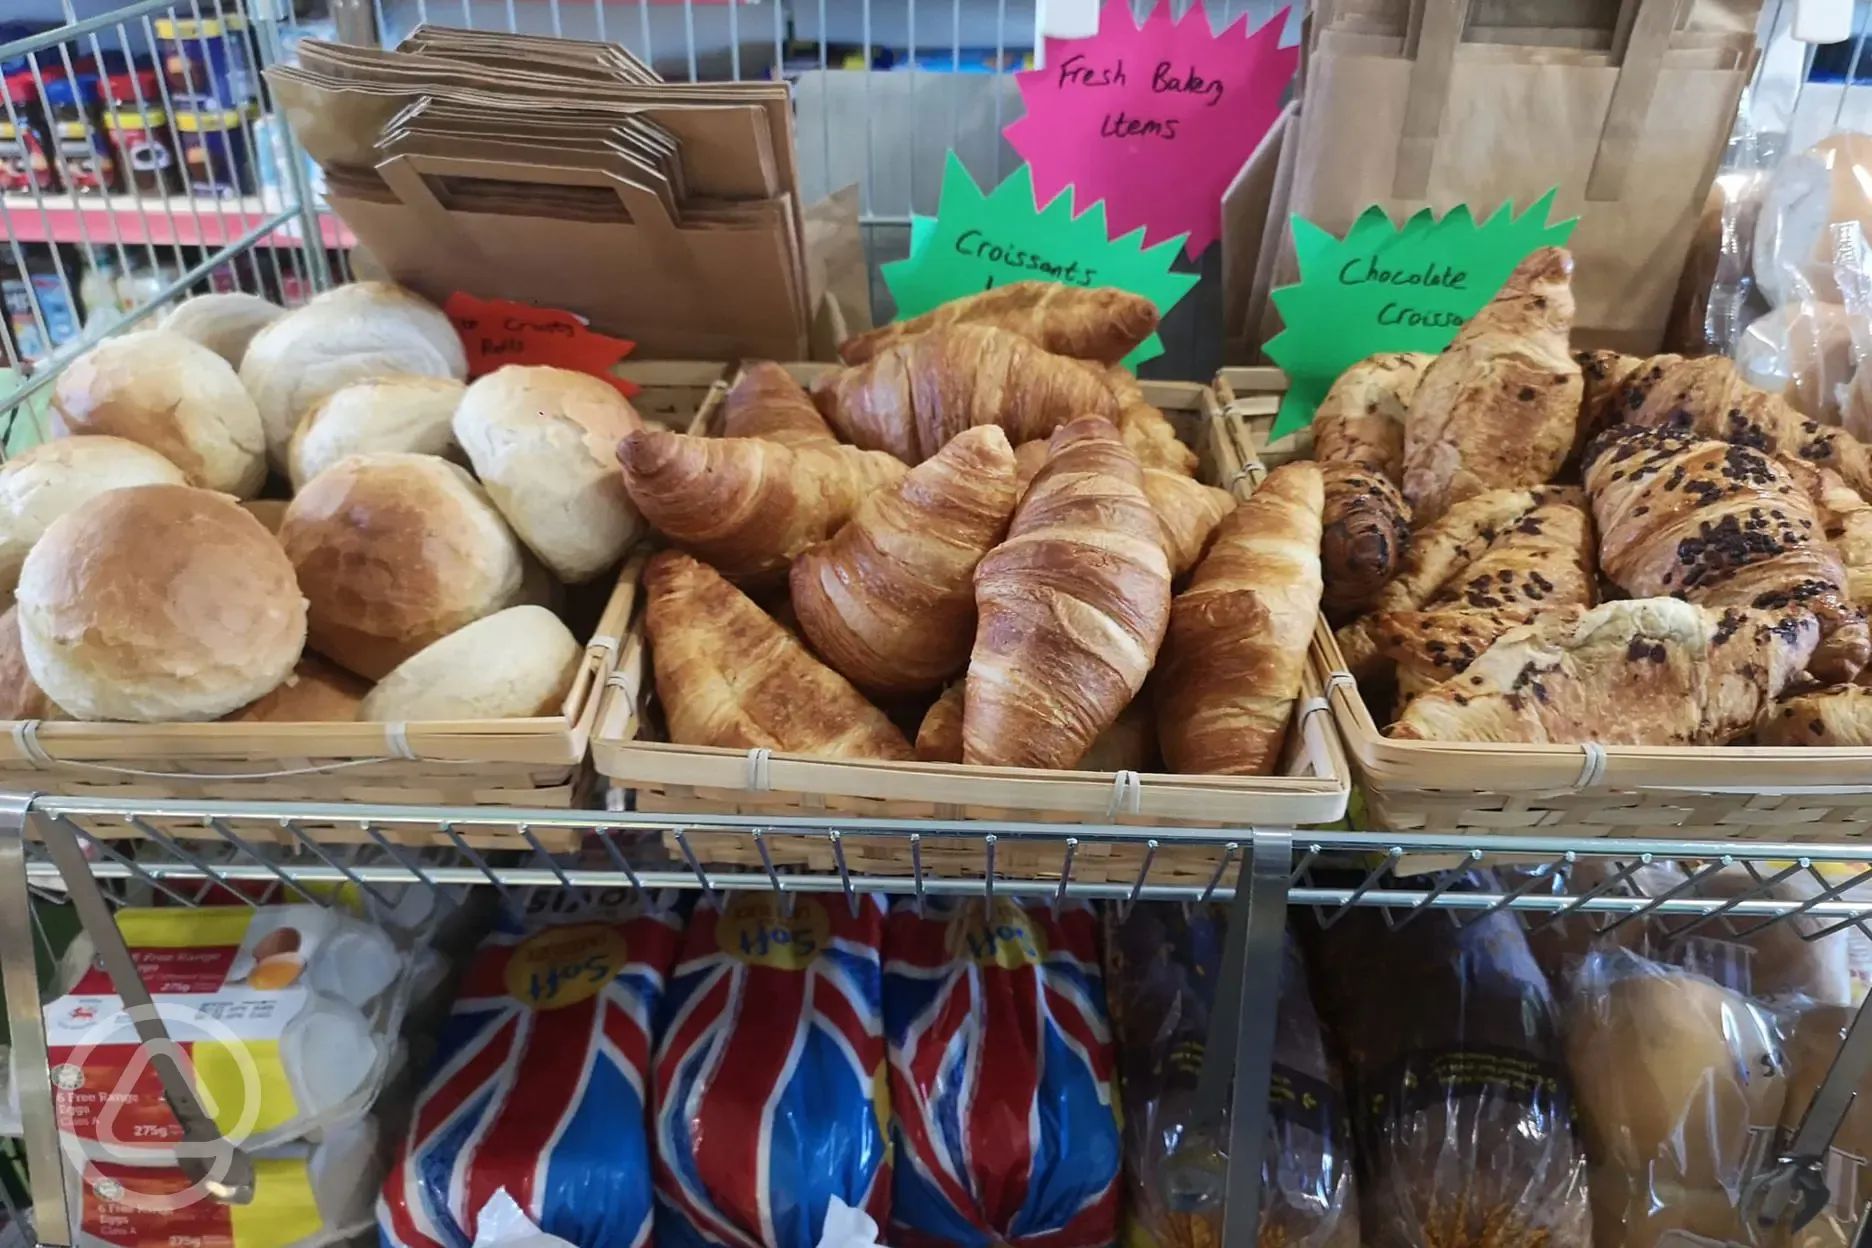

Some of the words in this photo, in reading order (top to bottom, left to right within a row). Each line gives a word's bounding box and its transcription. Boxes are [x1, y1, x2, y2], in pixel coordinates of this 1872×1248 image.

[1058, 55, 1126, 88] Fresh
[1101, 112, 1181, 140] Items
[955, 229, 1097, 287] Croissants
[1339, 254, 1467, 290] Chocolate
[133, 1125, 168, 1138] 275g
